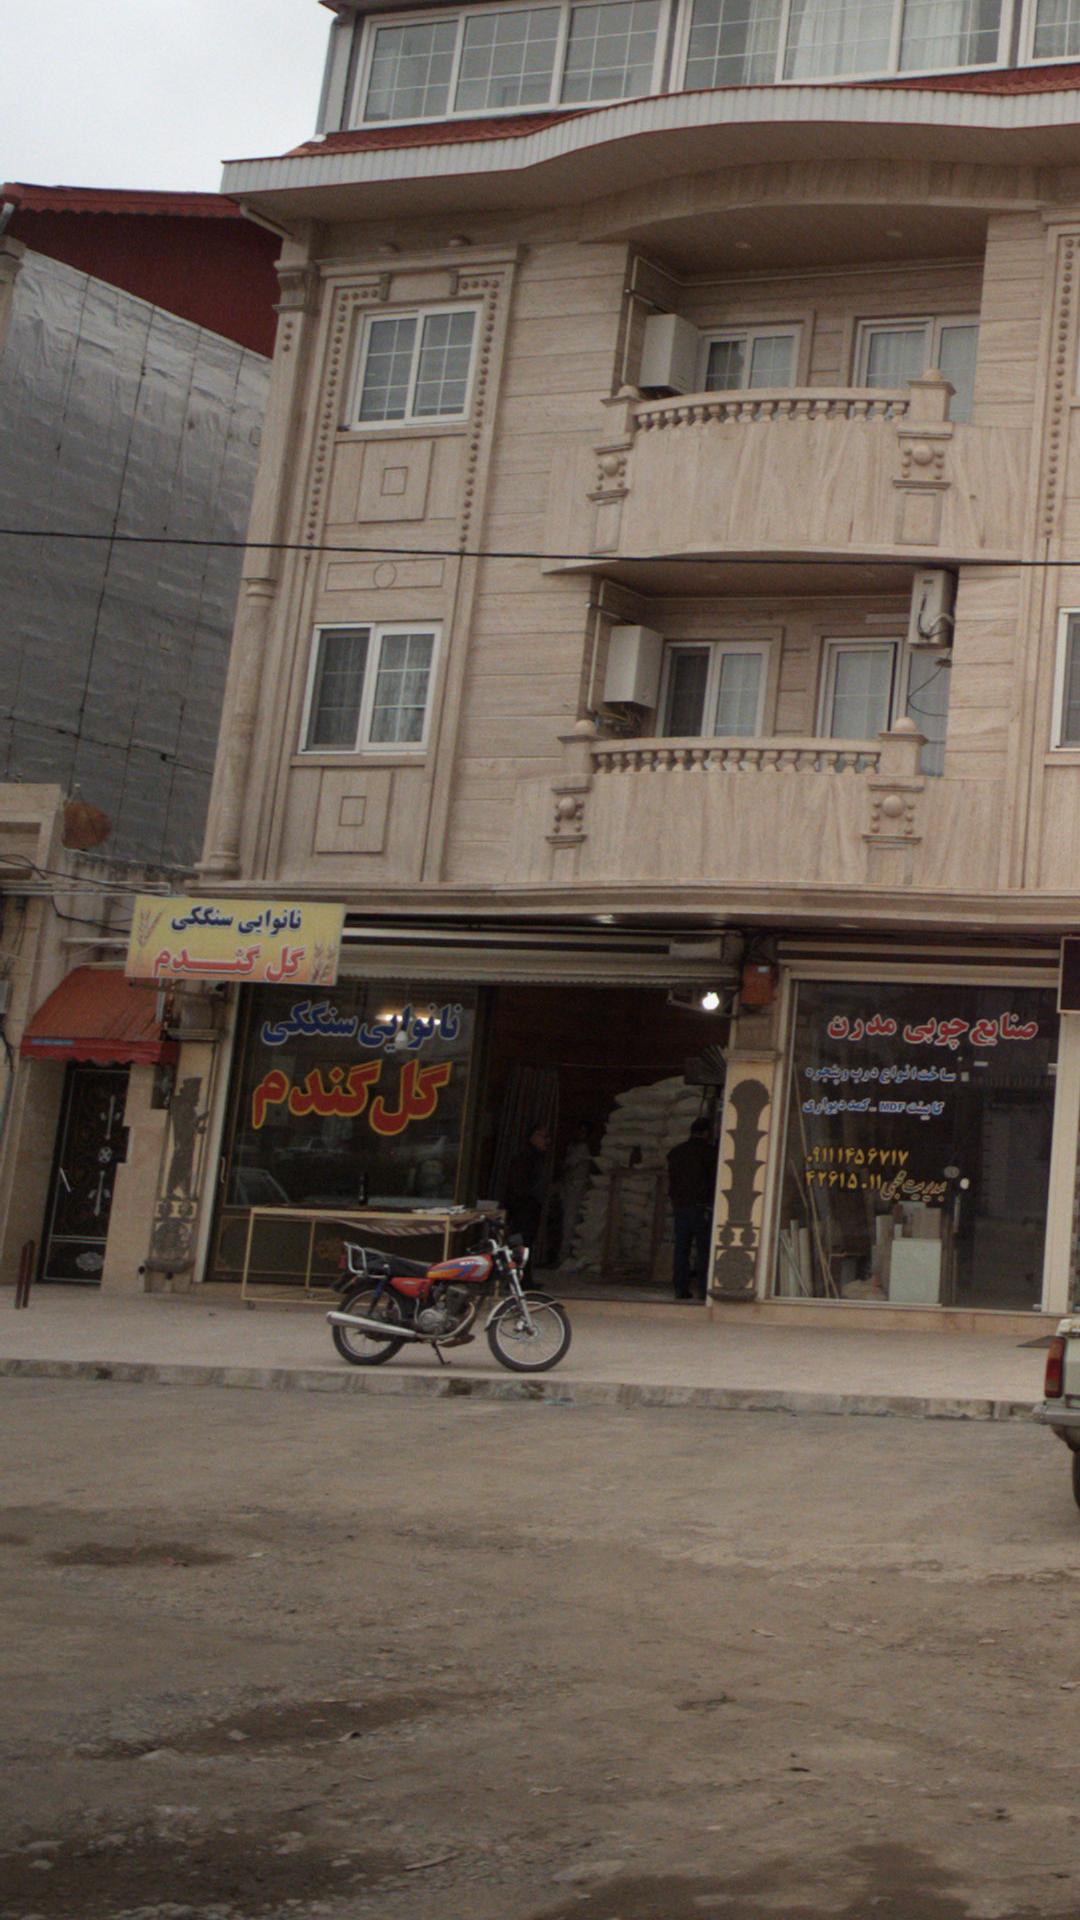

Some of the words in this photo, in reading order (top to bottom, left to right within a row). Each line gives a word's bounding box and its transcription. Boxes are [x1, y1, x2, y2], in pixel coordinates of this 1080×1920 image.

[171, 906, 233, 931] سنگکی
[238, 909, 302, 935] نانوایی
[153, 943, 260, 977] گندم
[265, 945, 304, 982] گل
[261, 1000, 357, 1046] سنگکی
[358, 1001, 463, 1053] نانوایی
[827, 1013, 897, 1040] مدرن
[903, 1016, 969, 1050] چوبی
[969, 1012, 1039, 1047] صنایع
[252, 1058, 382, 1130] گندم
[369, 1058, 452, 1136] گل
[879, 1101, 906, 1113] MDF
